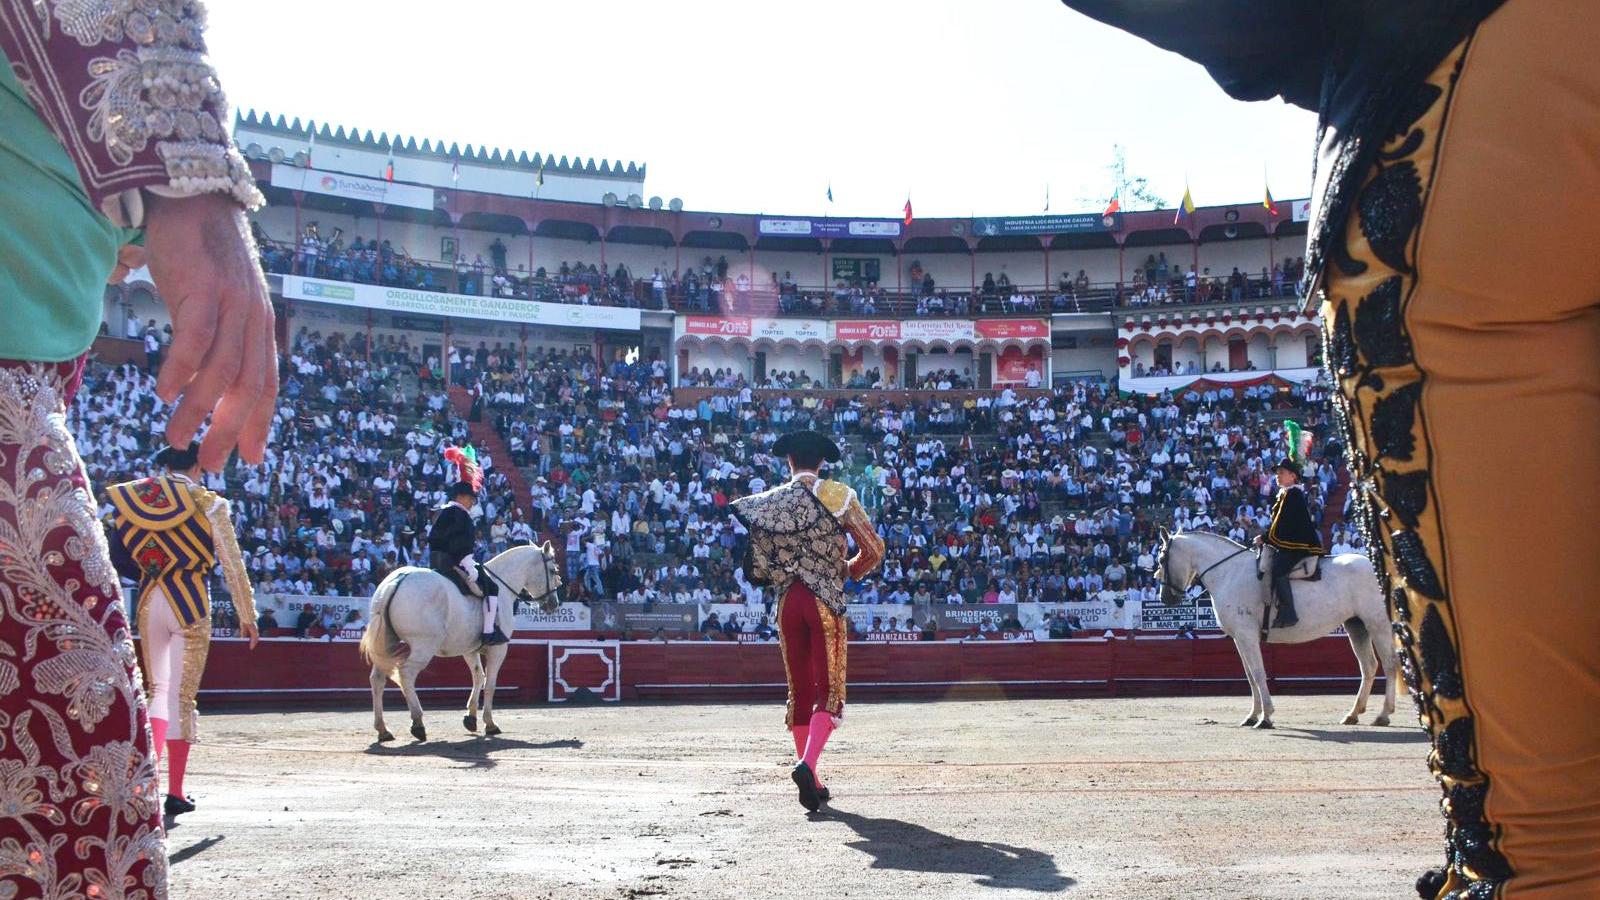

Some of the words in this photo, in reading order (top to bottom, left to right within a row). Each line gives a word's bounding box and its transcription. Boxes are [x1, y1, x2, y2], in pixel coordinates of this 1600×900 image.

[386, 290, 478, 308] ORGULLOSAMENTE
[480, 299, 540, 313] GANADEROS
[439, 305, 500, 317] SOSTENIBILIDAD
[719, 320, 735, 334] 70
[868, 325, 884, 338] 70
[532, 615, 576, 623] AMISTAD
[945, 610, 999, 618] BRINDEMOS
